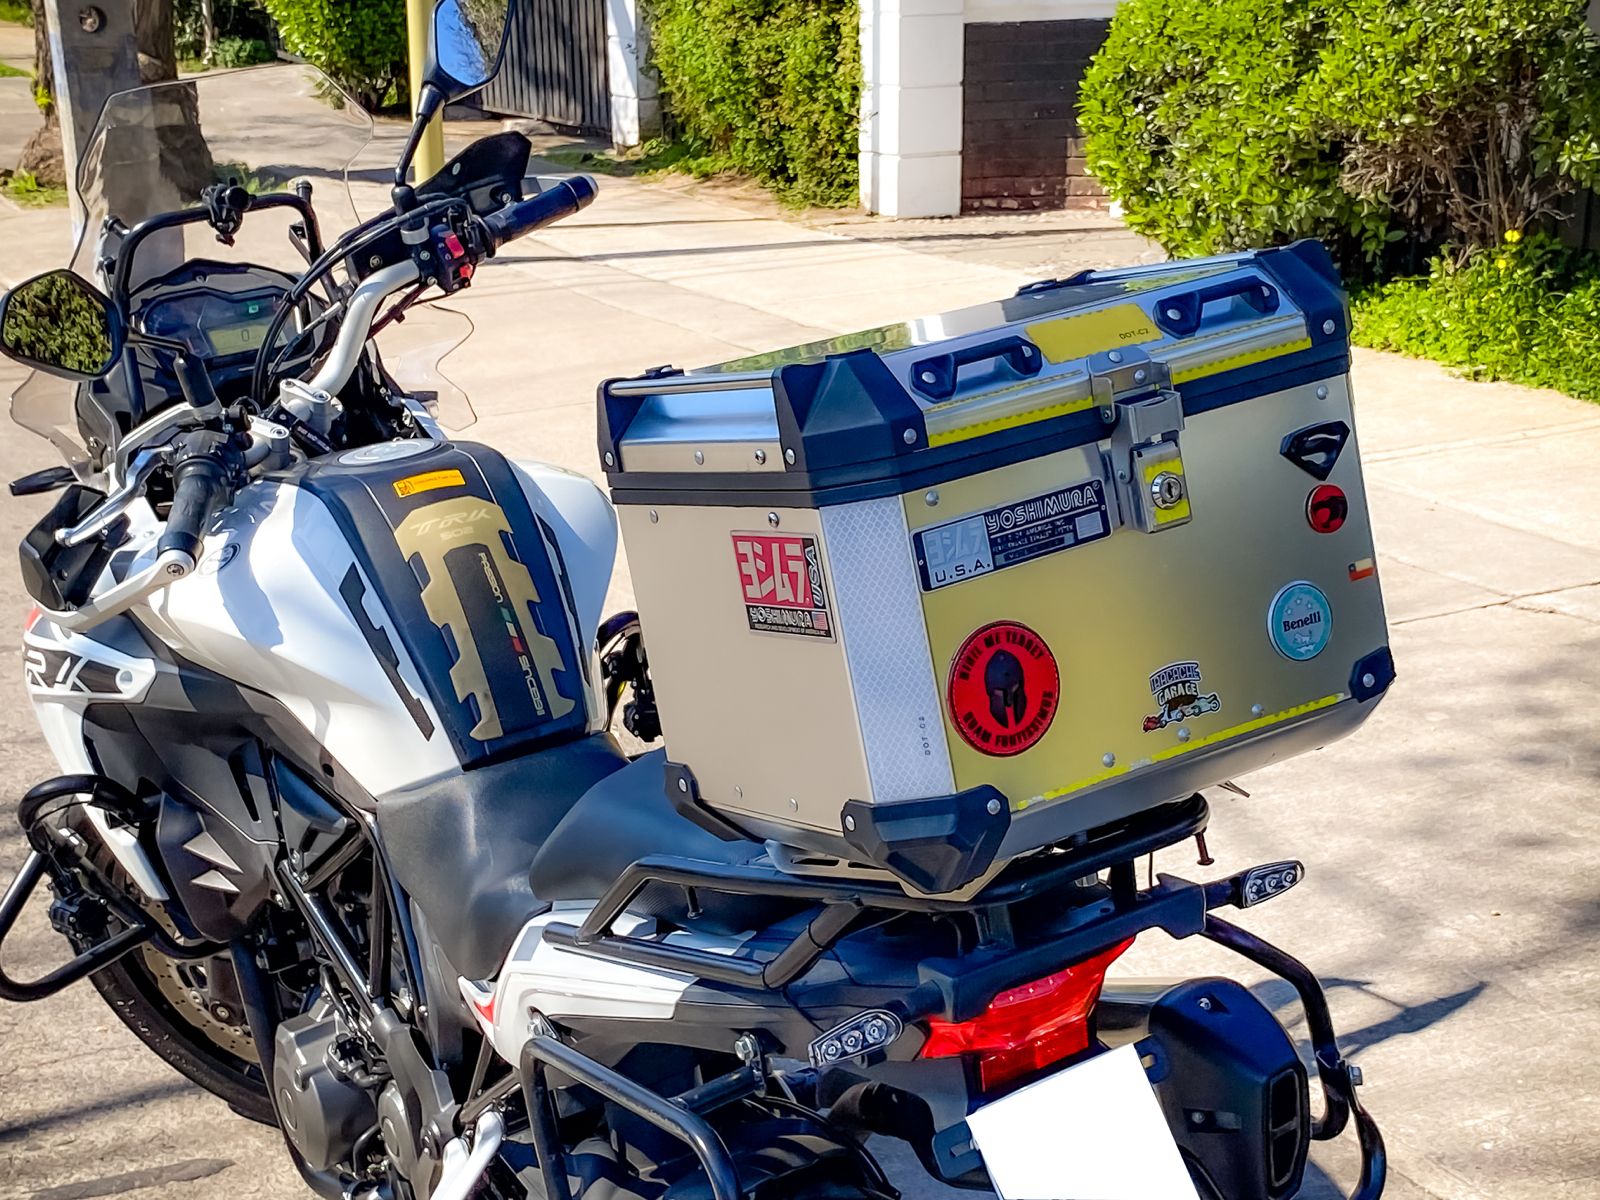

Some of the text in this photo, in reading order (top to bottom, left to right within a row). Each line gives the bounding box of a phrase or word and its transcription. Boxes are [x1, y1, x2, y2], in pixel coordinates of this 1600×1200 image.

[985, 485, 1098, 534] YOSHIMURA
[804, 545, 824, 606] USA
[1282, 610, 1322, 632] Benelli
[24, 647, 92, 693] RK
